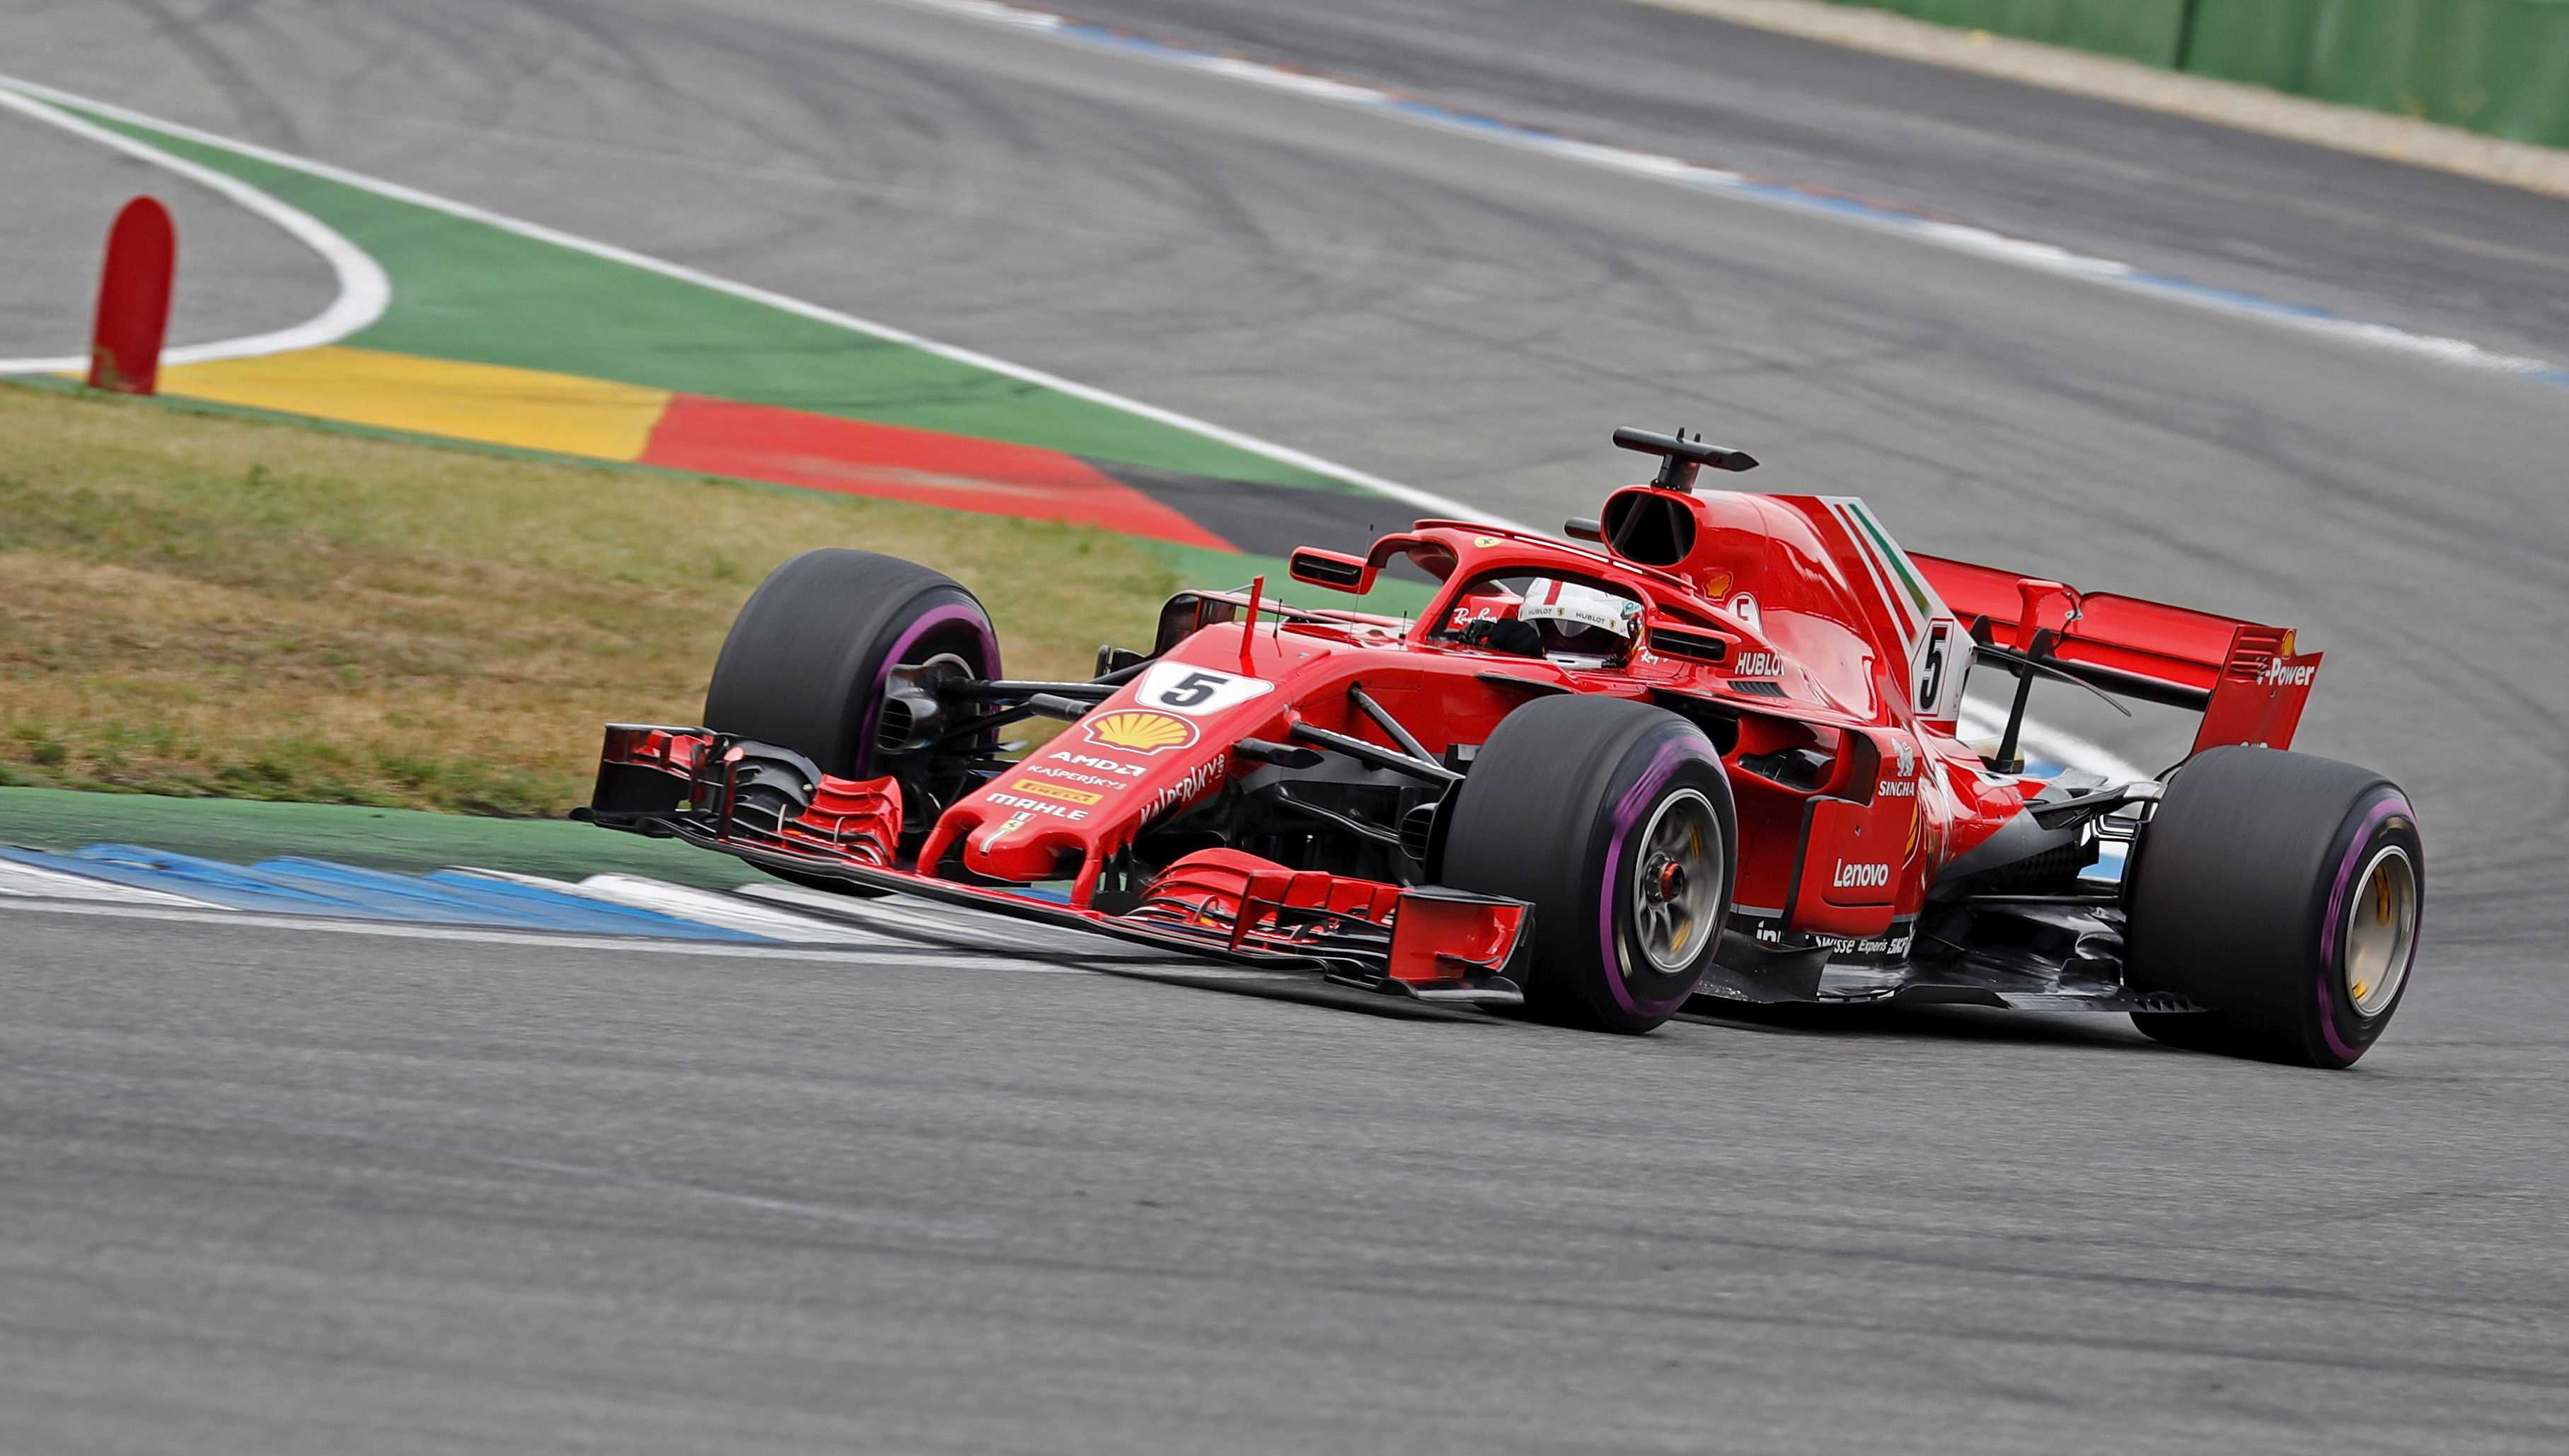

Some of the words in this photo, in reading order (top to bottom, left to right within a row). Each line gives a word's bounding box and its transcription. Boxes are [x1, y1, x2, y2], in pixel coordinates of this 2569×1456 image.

[1576, 611, 1605, 624] HUBLOT
[1920, 625, 1948, 712] 5
[1160, 673, 1230, 707] 5
[1048, 751, 1119, 772] AMD
[1027, 765, 1118, 788] KASPERSKY
[1022, 782, 1094, 802] PIRELLI
[1878, 780, 1915, 797] SINGHA
[986, 792, 1089, 821] MAHLE
[1833, 857, 1889, 887] Lenovo
[1857, 939, 1888, 955] Experis
